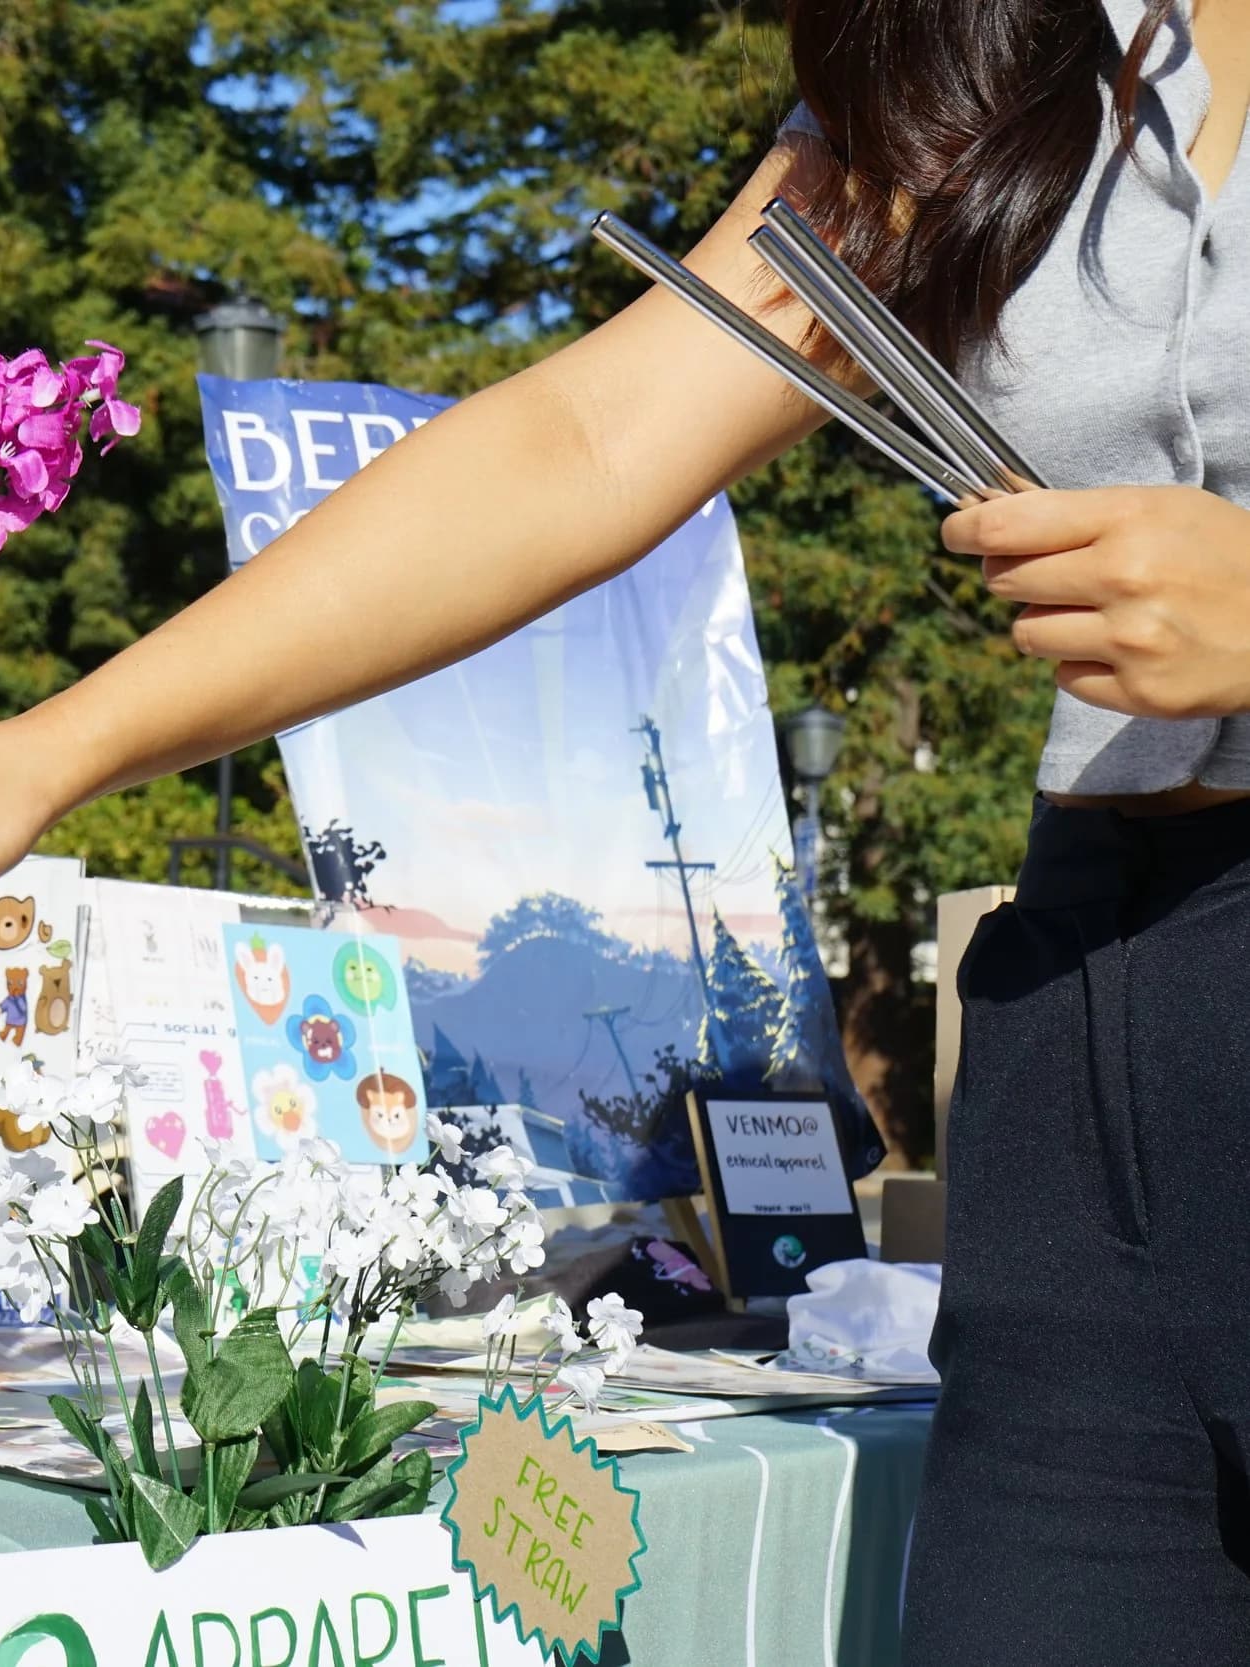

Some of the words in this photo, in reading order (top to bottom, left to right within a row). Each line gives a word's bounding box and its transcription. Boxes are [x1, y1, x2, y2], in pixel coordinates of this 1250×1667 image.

[164, 1023, 218, 1037] social
[726, 1114, 818, 1137] VENMO@
[517, 1456, 594, 1549] FREE
[484, 1496, 588, 1615] STRAW
